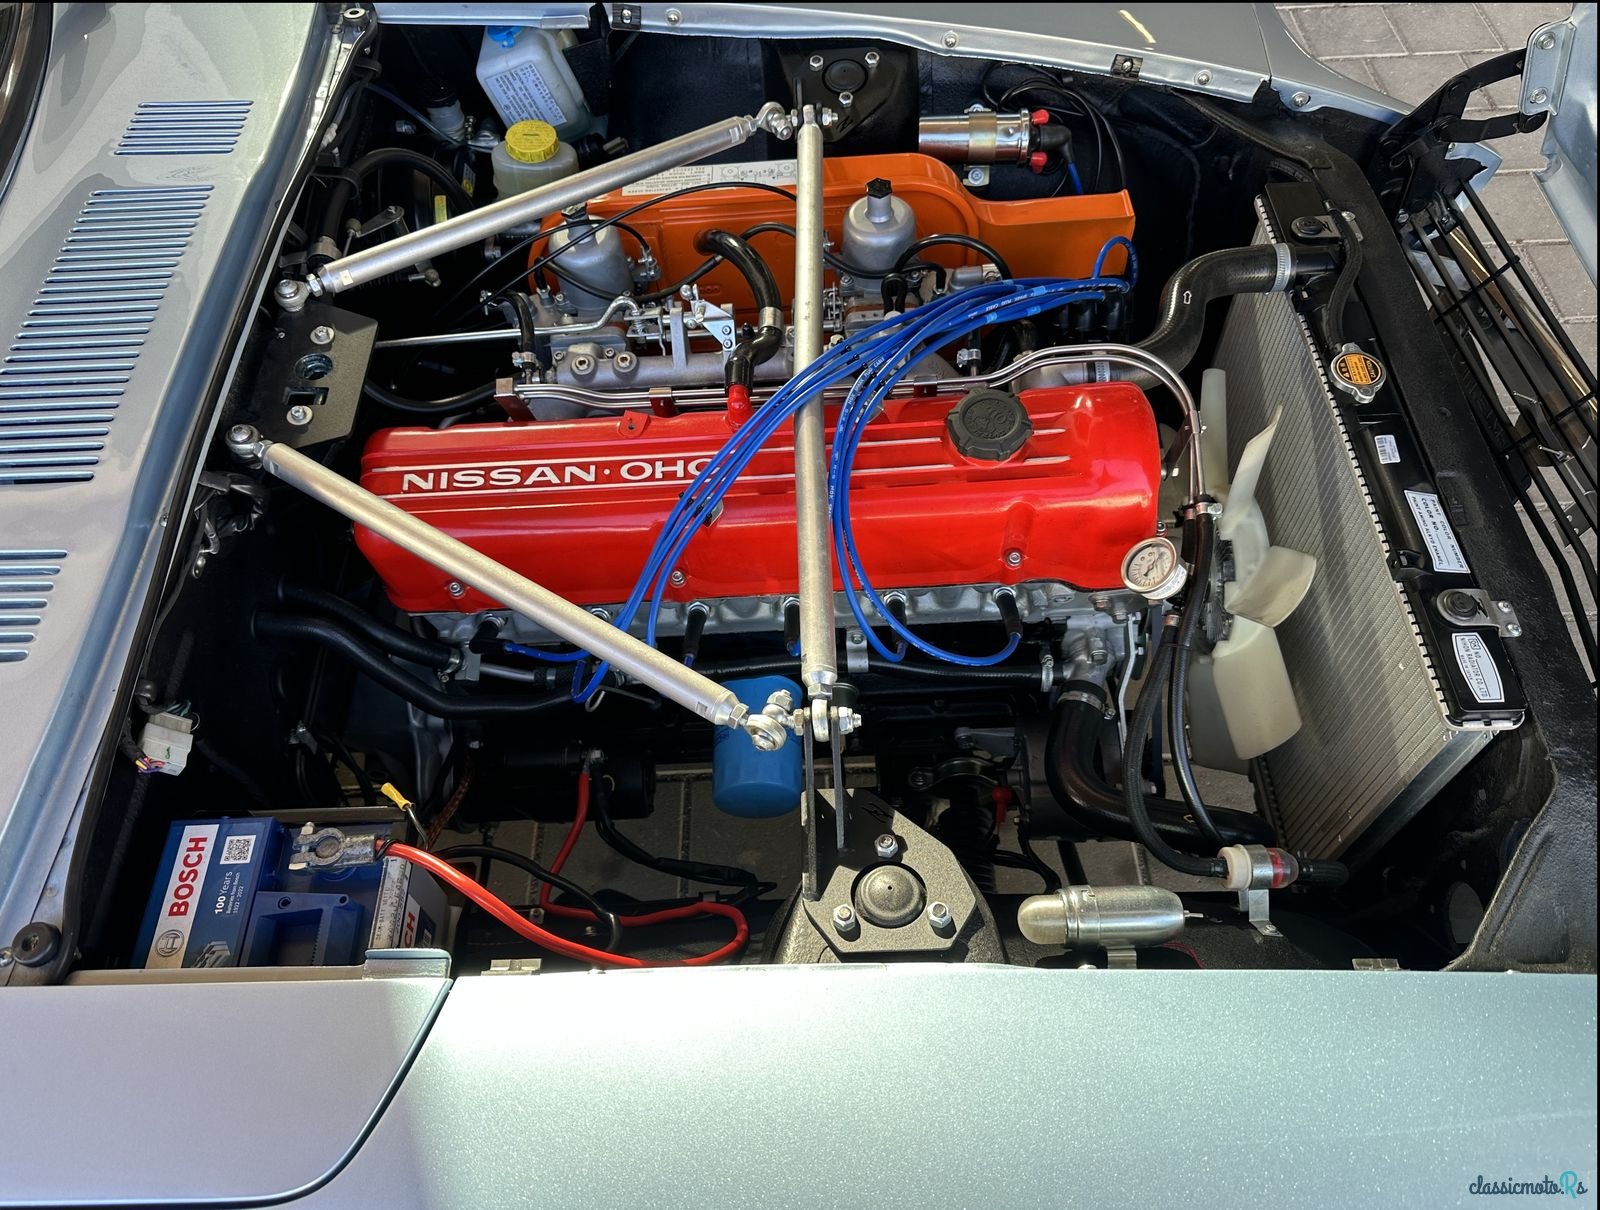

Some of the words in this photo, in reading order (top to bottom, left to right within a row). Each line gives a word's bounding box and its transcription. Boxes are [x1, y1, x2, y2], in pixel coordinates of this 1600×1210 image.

[986, 304, 999, 312] CABLE
[1366, 360, 1376, 378] CAUTION
[402, 464, 596, 491] NISSAN
[1422, 498, 1434, 518] COLOR
[1412, 496, 1421, 510] PAINT
[1432, 545, 1443, 565] ENAMEL
[1431, 499, 1441, 515] PAINT
[1440, 521, 1451, 540] COLOR
[1451, 544, 1464, 568] NUMBER
[168, 837, 208, 917] BOSCH
[214, 895, 226, 914] 100
[220, 871, 233, 895] Years
